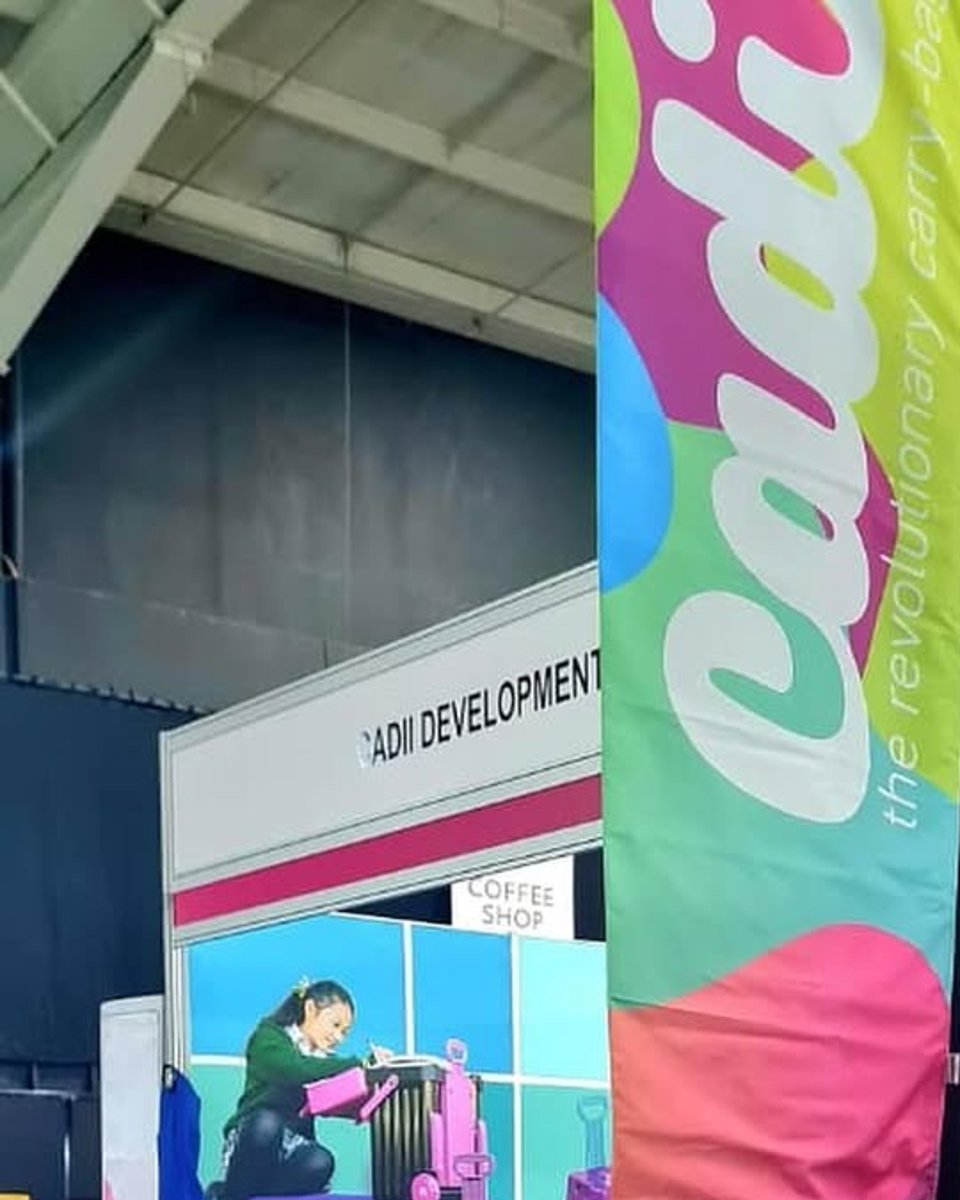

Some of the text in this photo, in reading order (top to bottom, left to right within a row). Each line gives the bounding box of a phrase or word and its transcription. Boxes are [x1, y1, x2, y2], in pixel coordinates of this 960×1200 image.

[879, 294, 948, 716] revolutionary
[357, 715, 414, 768] ADII
[878, 736, 920, 829] the
[467, 879, 554, 908] COFFEE
[481, 903, 544, 931] SHOP
